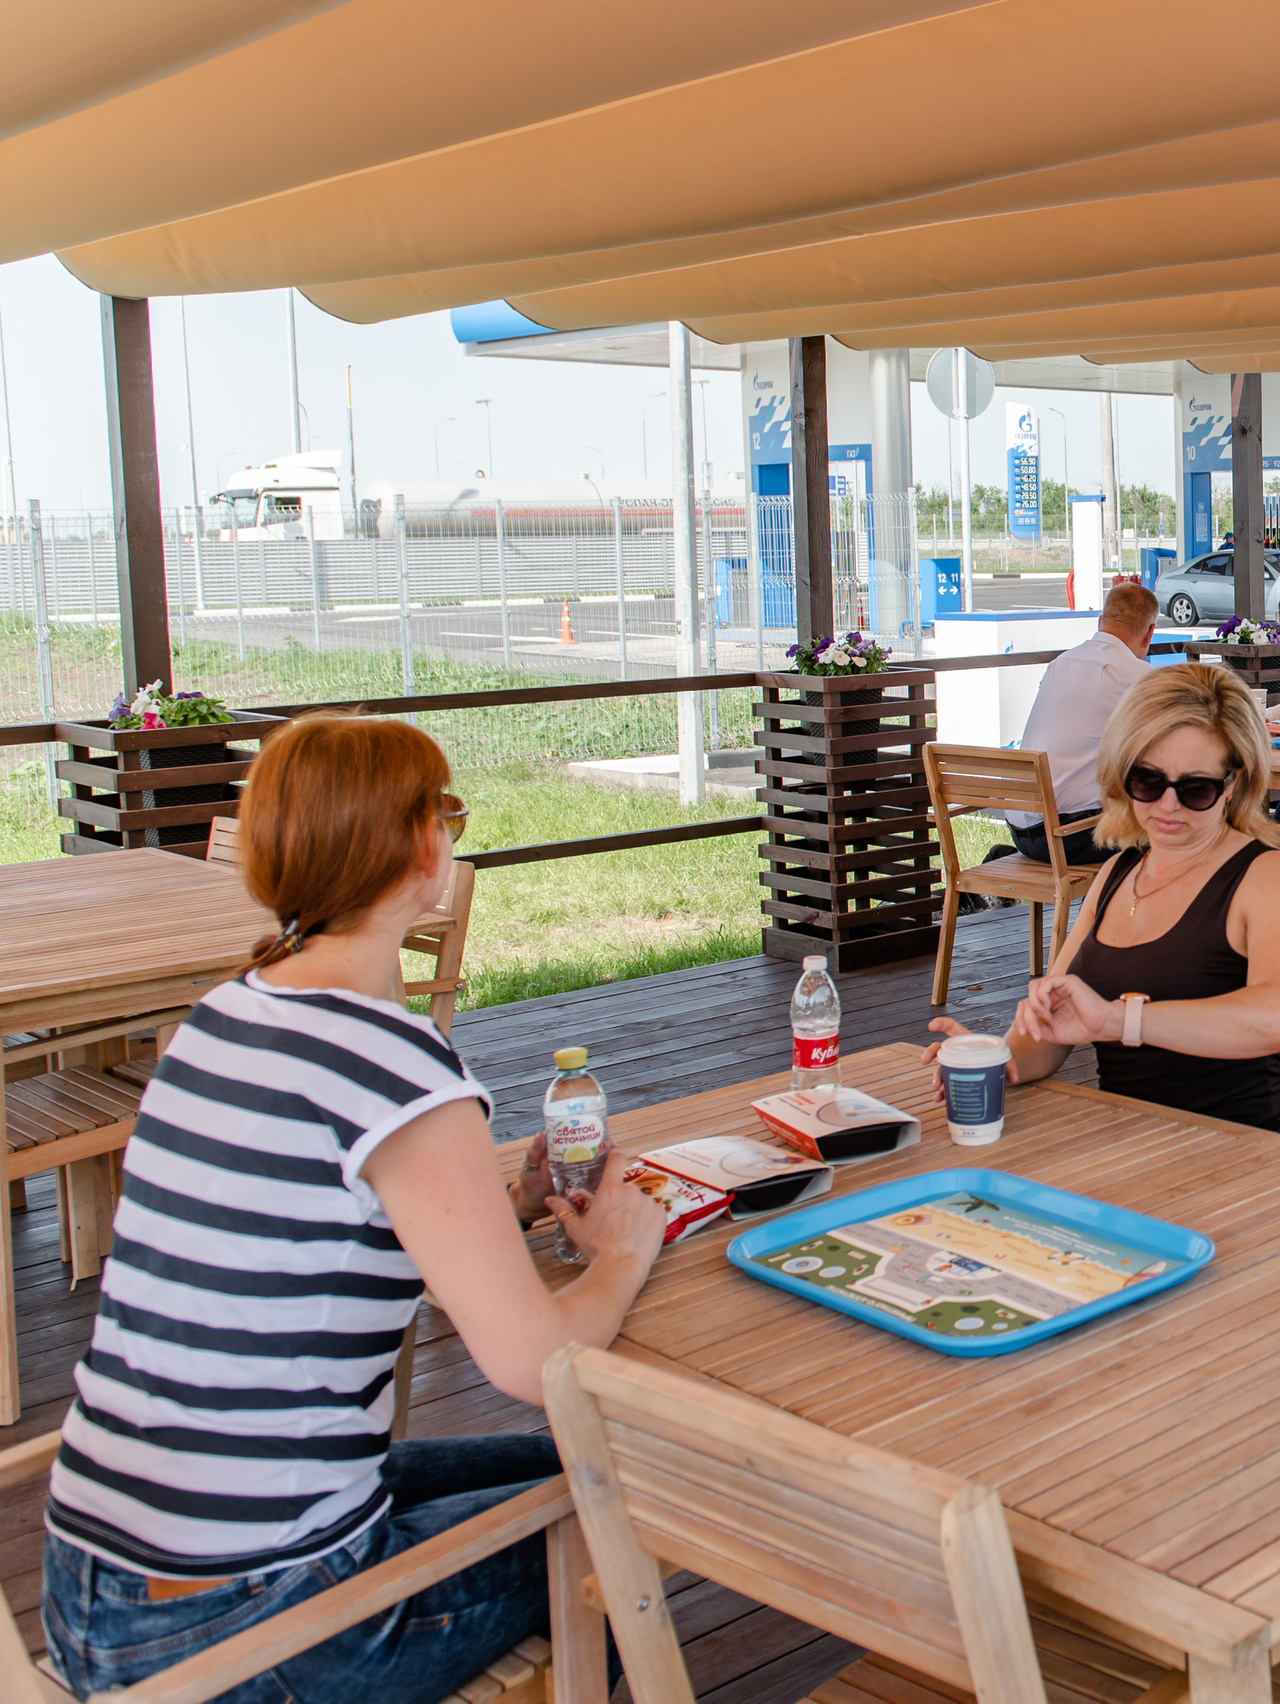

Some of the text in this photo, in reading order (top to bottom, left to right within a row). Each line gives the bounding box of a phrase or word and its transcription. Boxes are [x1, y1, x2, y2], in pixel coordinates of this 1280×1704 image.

[752, 432, 761, 450] 12
[1186, 446, 1196, 461] 10
[1273, 459, 1280, 468] 92
[937, 572, 959, 583] 12 11
